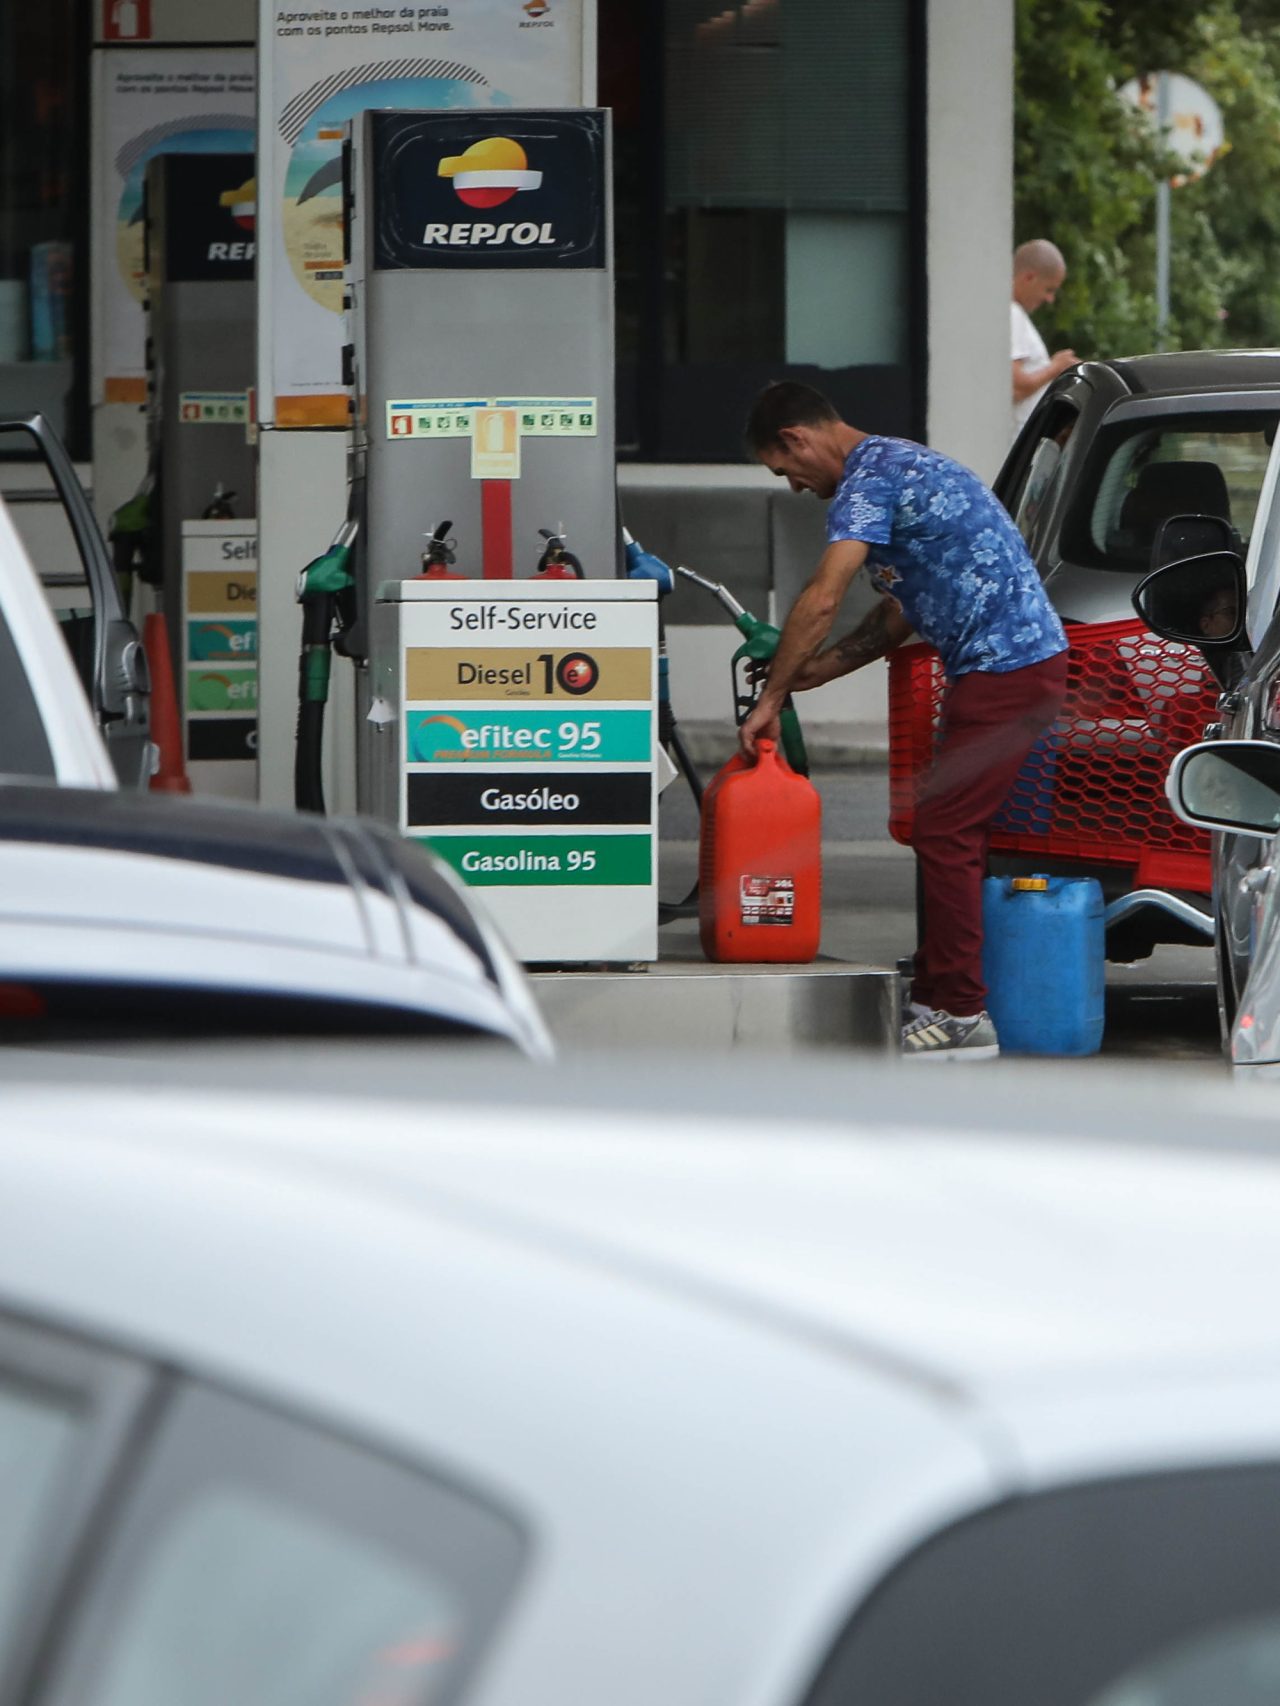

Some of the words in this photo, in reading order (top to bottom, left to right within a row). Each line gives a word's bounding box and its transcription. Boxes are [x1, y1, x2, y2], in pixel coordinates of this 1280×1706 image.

[277, 11, 337, 23] Aproveite
[341, 12, 348, 20] o
[352, 8, 395, 20] melhor
[400, 7, 414, 19] da
[418, 6, 449, 20] praia
[518, 20, 555, 29] REPSOL
[277, 27, 303, 37] com
[307, 26, 321, 36] os
[325, 24, 368, 38] pontos
[371, 21, 415, 35] Repsol
[418, 20, 454, 33] Move.
[423, 222, 556, 244] REPSOL
[450, 605, 597, 630] Self-Service
[457, 662, 531, 685] Diesel
[460, 725, 552, 748] efitec
[558, 722, 601, 751] 95
[480, 787, 580, 810] Gasóleo
[461, 850, 561, 872] Gasolina
[566, 850, 596, 871] 95
